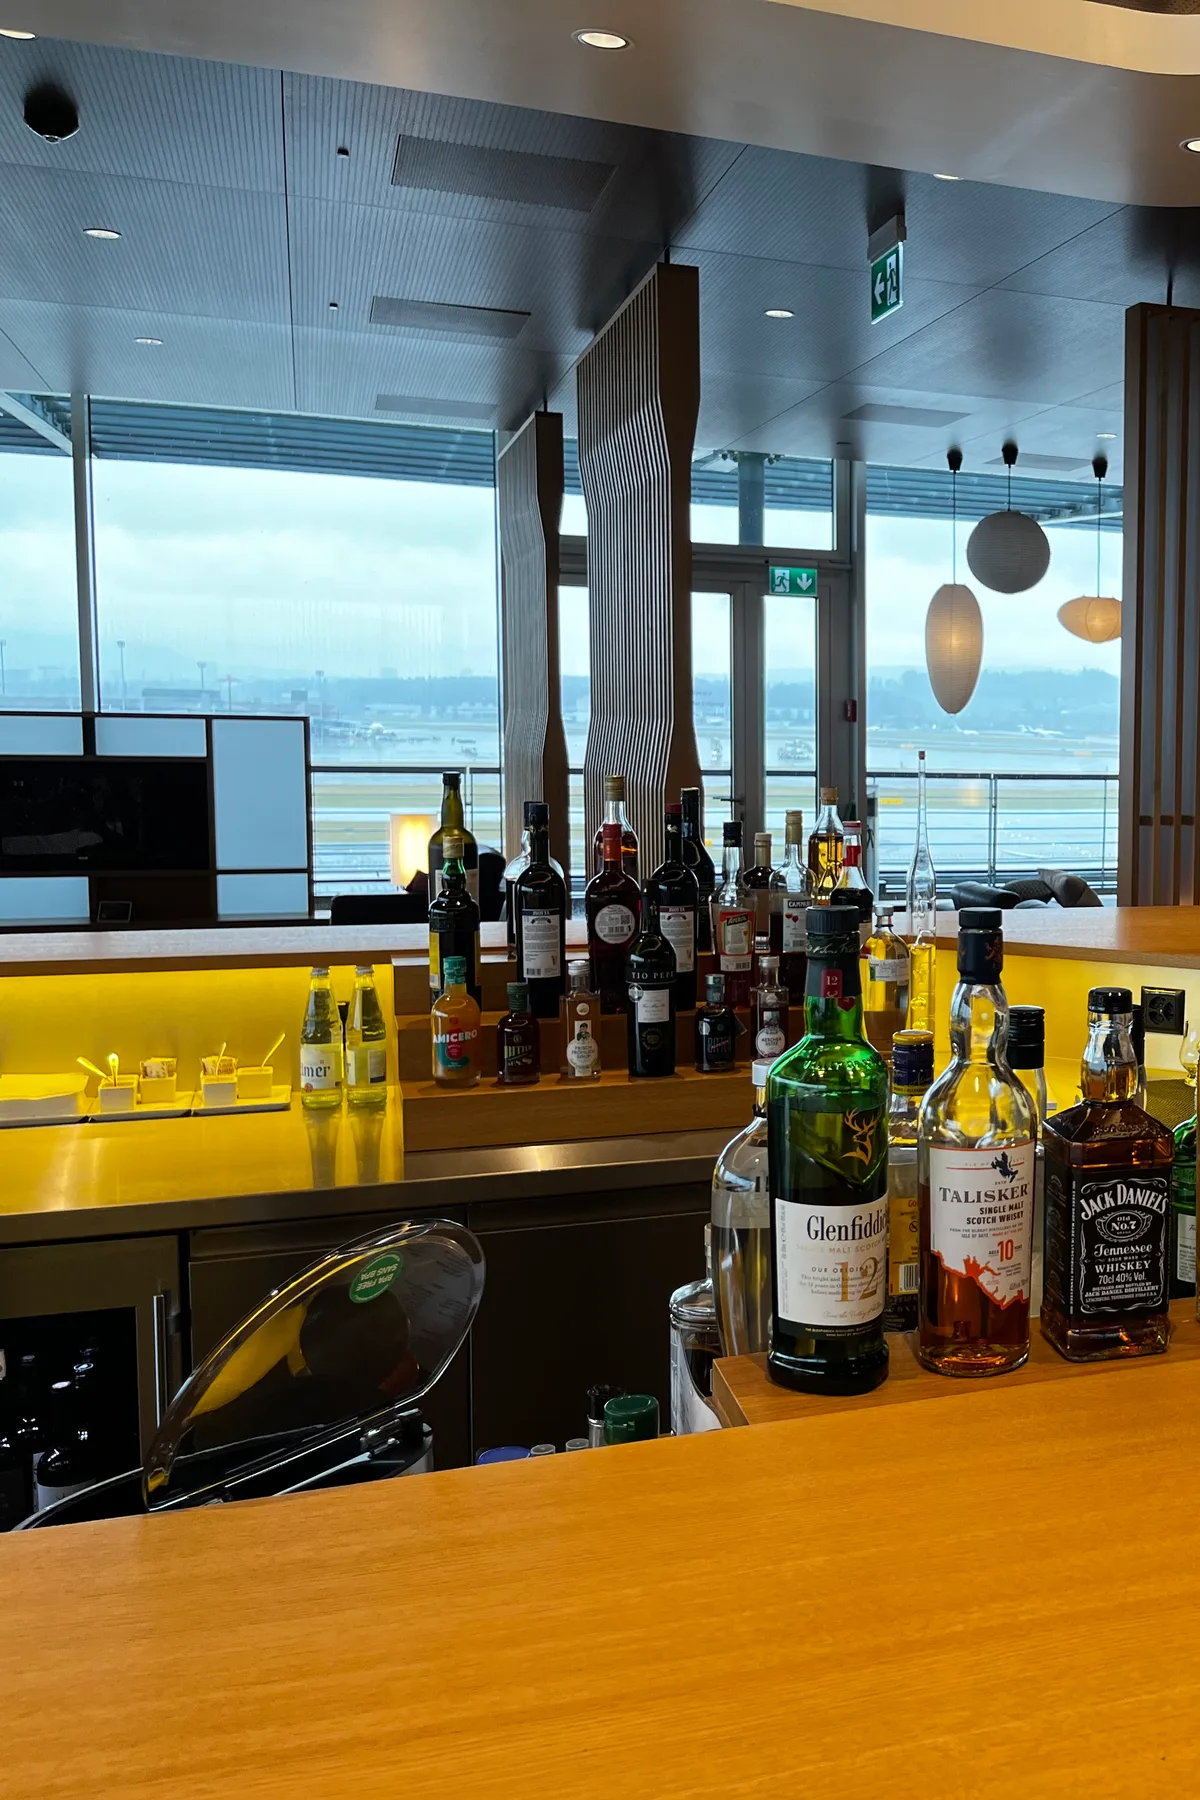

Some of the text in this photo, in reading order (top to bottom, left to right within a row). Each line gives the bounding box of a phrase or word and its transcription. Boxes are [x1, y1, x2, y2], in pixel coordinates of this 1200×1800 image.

[631, 971, 649, 980] TIO
[826, 976, 838, 986] 12
[432, 1029, 478, 1044] AMICERO
[939, 1183, 1028, 1205] TALISKER
[980, 1201, 1024, 1215] SINGLE MALT
[1080, 1184, 1168, 1220] JACK DANIEL'S
[966, 1211, 1024, 1225] SCOTCH WHISKY
[1111, 1220, 1136, 1231] No.7
[829, 1246, 851, 1254] MALT
[997, 1239, 1014, 1262] 10
[1094, 1244, 1152, 1257] Tennessee
[361, 1264, 398, 1281] SANS BPA
[1095, 1260, 1151, 1273] WHISKEY
[356, 1273, 394, 1291] BPA FREE
[834, 1256, 878, 1303] 12
[1099, 1271, 1147, 1285] 70cl 40% Vol.
[1102, 1288, 1123, 1296] DANIEL
[1124, 1285, 1159, 1293] DISTILLERY
